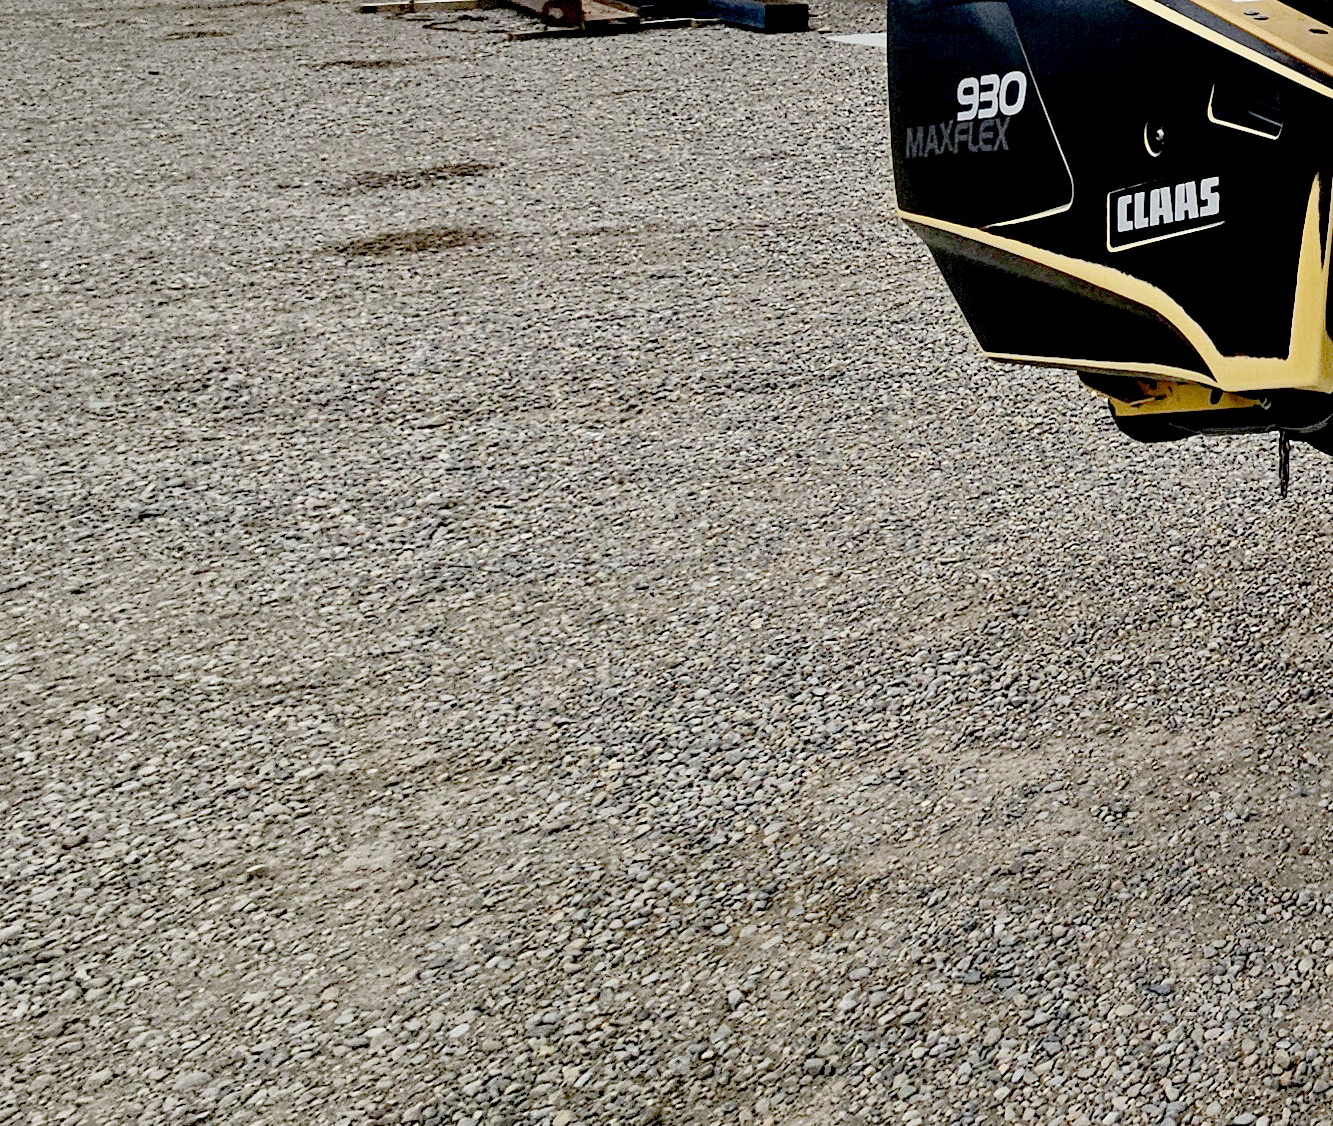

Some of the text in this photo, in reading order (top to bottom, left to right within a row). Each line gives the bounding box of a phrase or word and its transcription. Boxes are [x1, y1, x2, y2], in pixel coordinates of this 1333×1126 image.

[957, 71, 1027, 121] 930
[906, 117, 1010, 158] MAXFLEX
[1117, 176, 1220, 232] CLAAS
